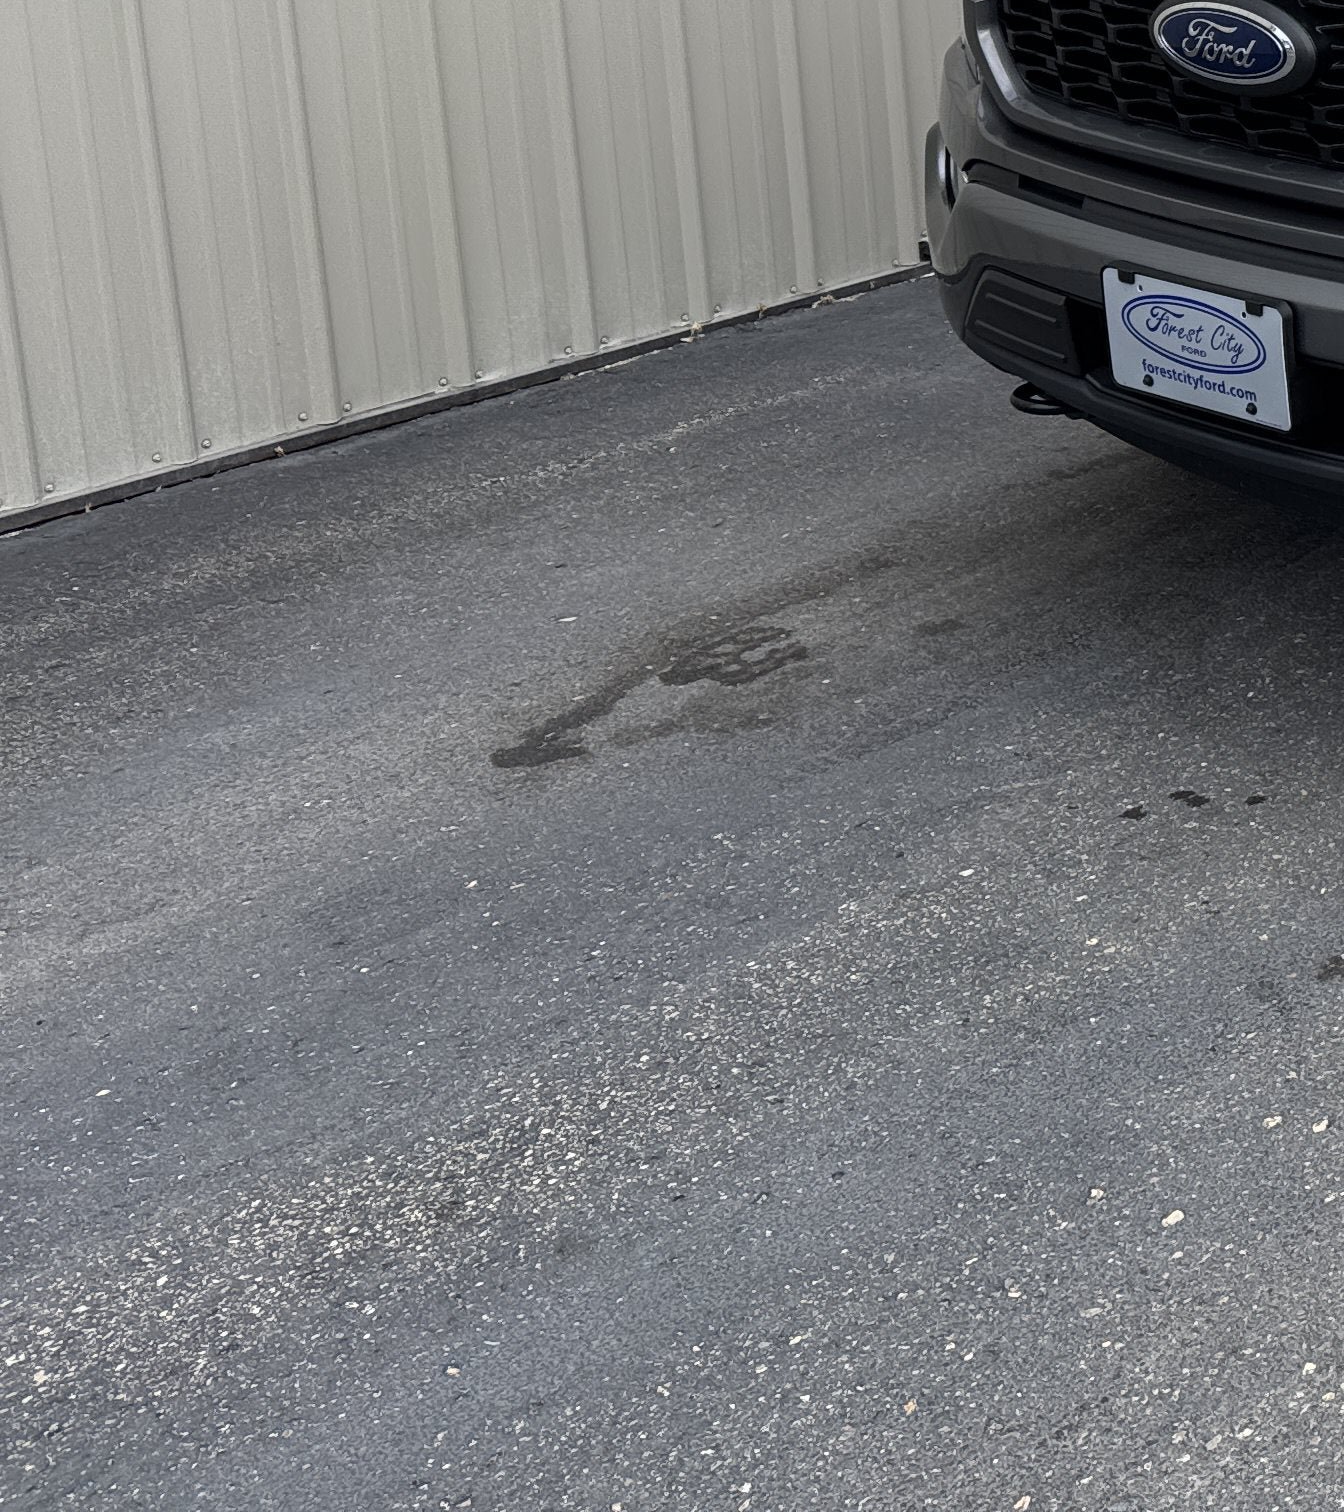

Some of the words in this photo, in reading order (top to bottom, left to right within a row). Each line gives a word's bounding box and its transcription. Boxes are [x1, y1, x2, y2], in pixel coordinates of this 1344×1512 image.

[1181, 18, 1257, 68] Ford
[1145, 305, 1204, 343] Forest
[1210, 324, 1245, 364] City
[1181, 344, 1207, 358] FORD
[1141, 358, 1257, 402] forestcityford.com
